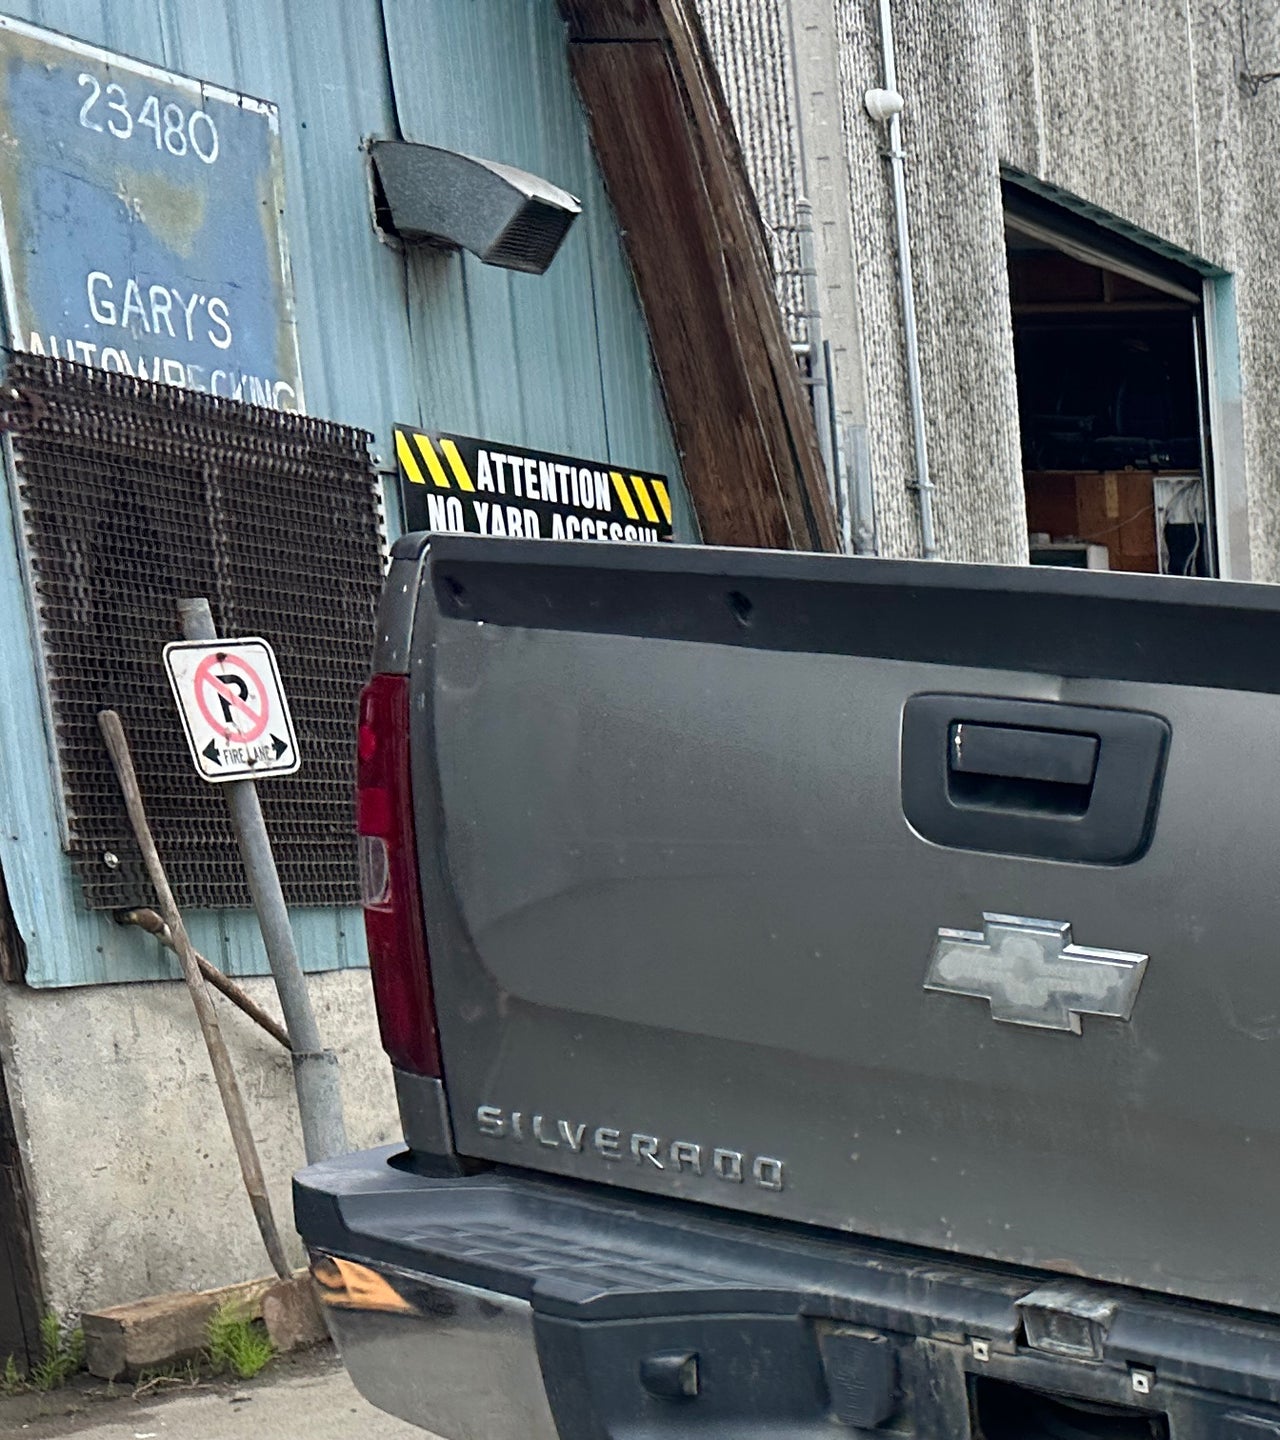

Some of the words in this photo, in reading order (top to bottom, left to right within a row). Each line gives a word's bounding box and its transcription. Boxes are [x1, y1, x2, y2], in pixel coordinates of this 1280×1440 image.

[77, 72, 220, 165] 23480
[86, 271, 233, 350] GARY'S
[426, 493, 465, 533] NO
[472, 499, 541, 540] YARD
[476, 449, 612, 513] ATTENTION
[222, 747, 247, 766] FIRE
[477, 1105, 785, 1192] SILVERADO
